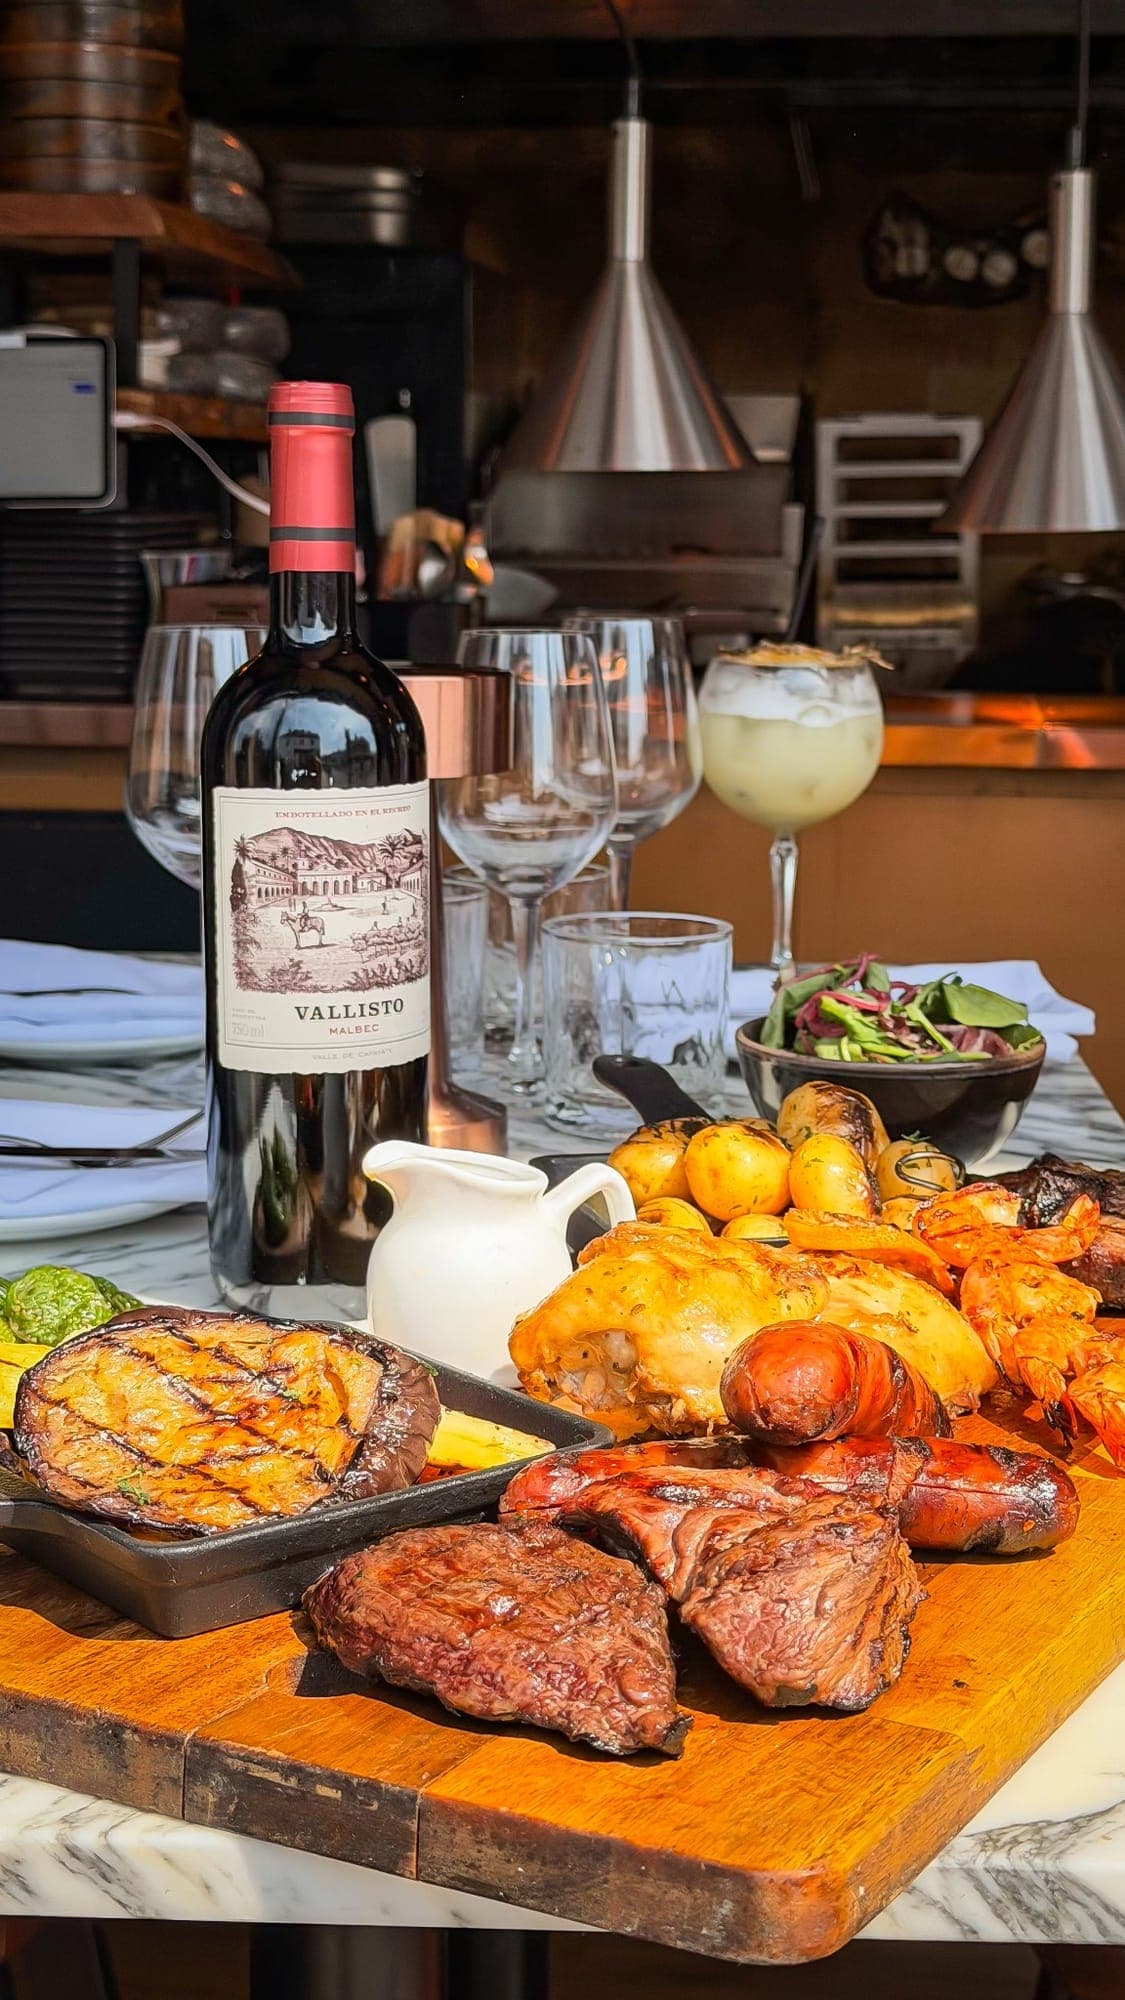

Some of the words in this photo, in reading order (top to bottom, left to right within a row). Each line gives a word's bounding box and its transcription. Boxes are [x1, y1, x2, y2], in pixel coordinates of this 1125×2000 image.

[275, 810, 353, 819] EMBOTELLADO
[355, 809, 368, 817] EN
[370, 808, 382, 816] EL
[294, 998, 404, 1020] VALLISTO
[329, 1024, 379, 1035] MALBEC
